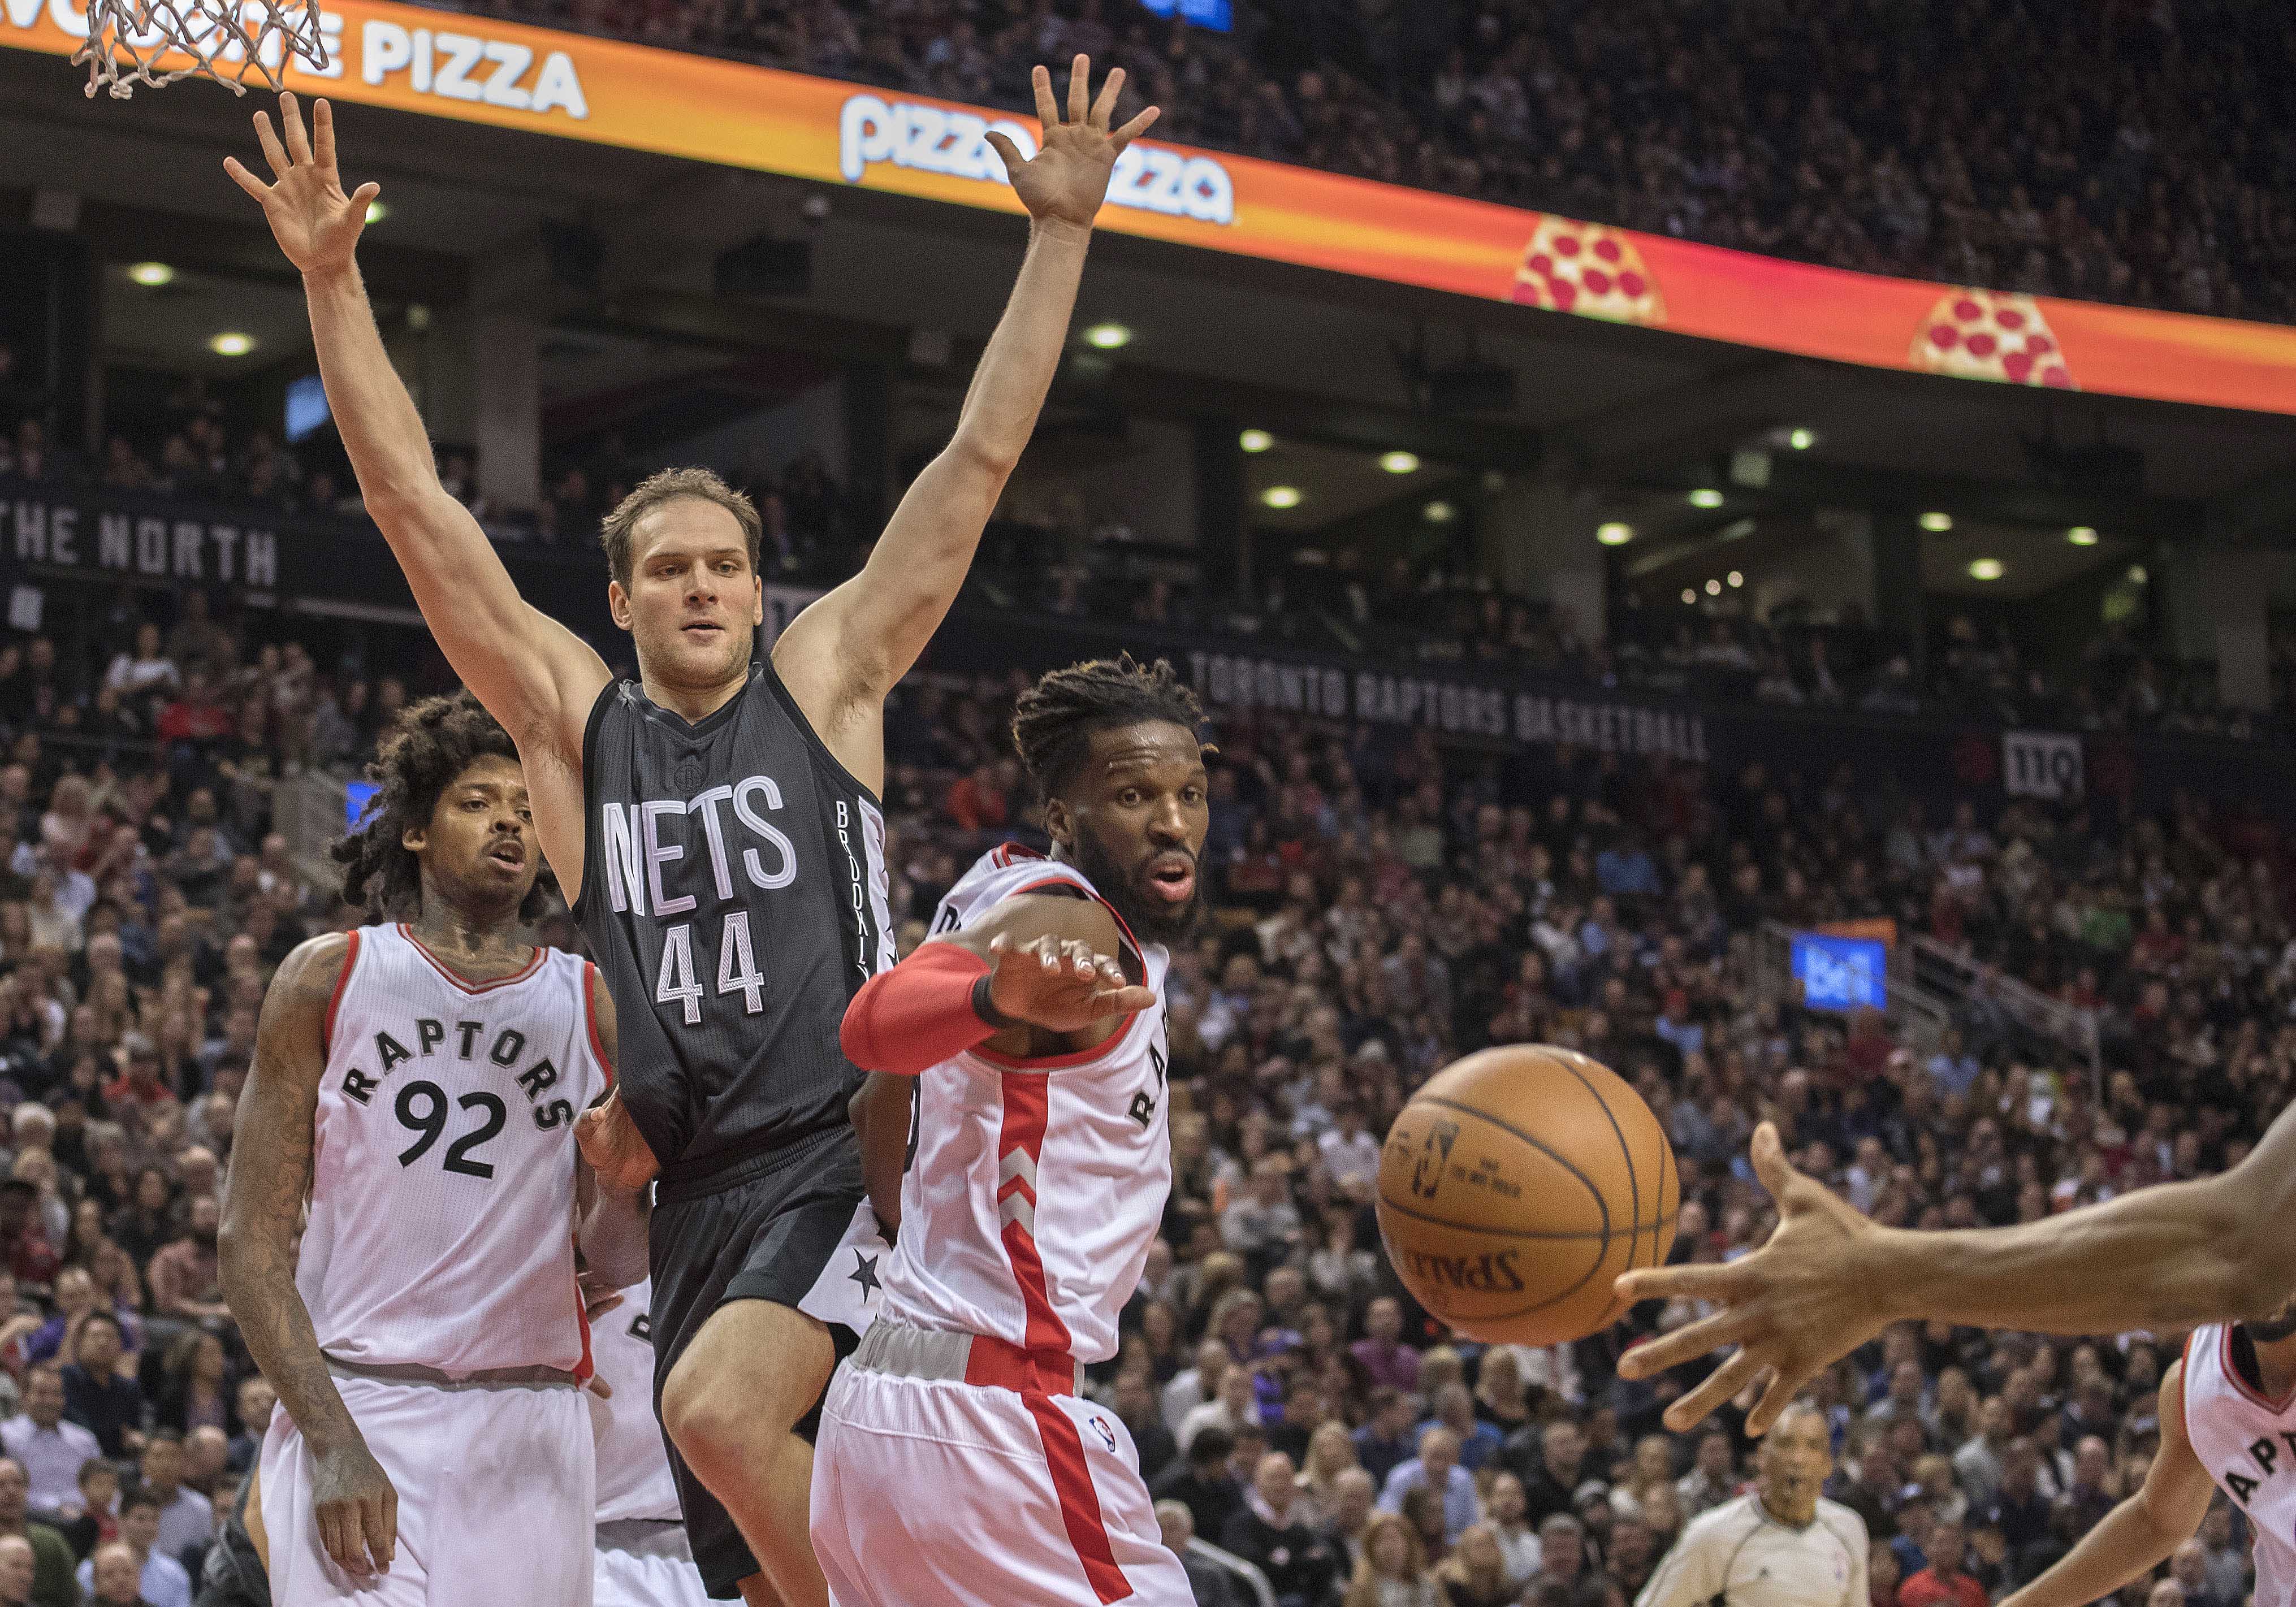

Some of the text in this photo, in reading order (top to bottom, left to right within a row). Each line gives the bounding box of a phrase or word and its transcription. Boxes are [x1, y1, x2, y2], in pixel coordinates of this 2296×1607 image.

[362, 19, 589, 119] PIZZA
[1103, 144, 1234, 226] zza
[98, 513, 277, 587] NORTH
[1188, 651, 1709, 761] TORONTO RAPTORS BASKETBALL
[603, 776, 796, 916] NETS
[836, 800, 869, 982] BROOKLY
[656, 911, 764, 1025] 44
[341, 1017, 574, 1132] RAPTORS
[395, 1080, 507, 1180] 92
